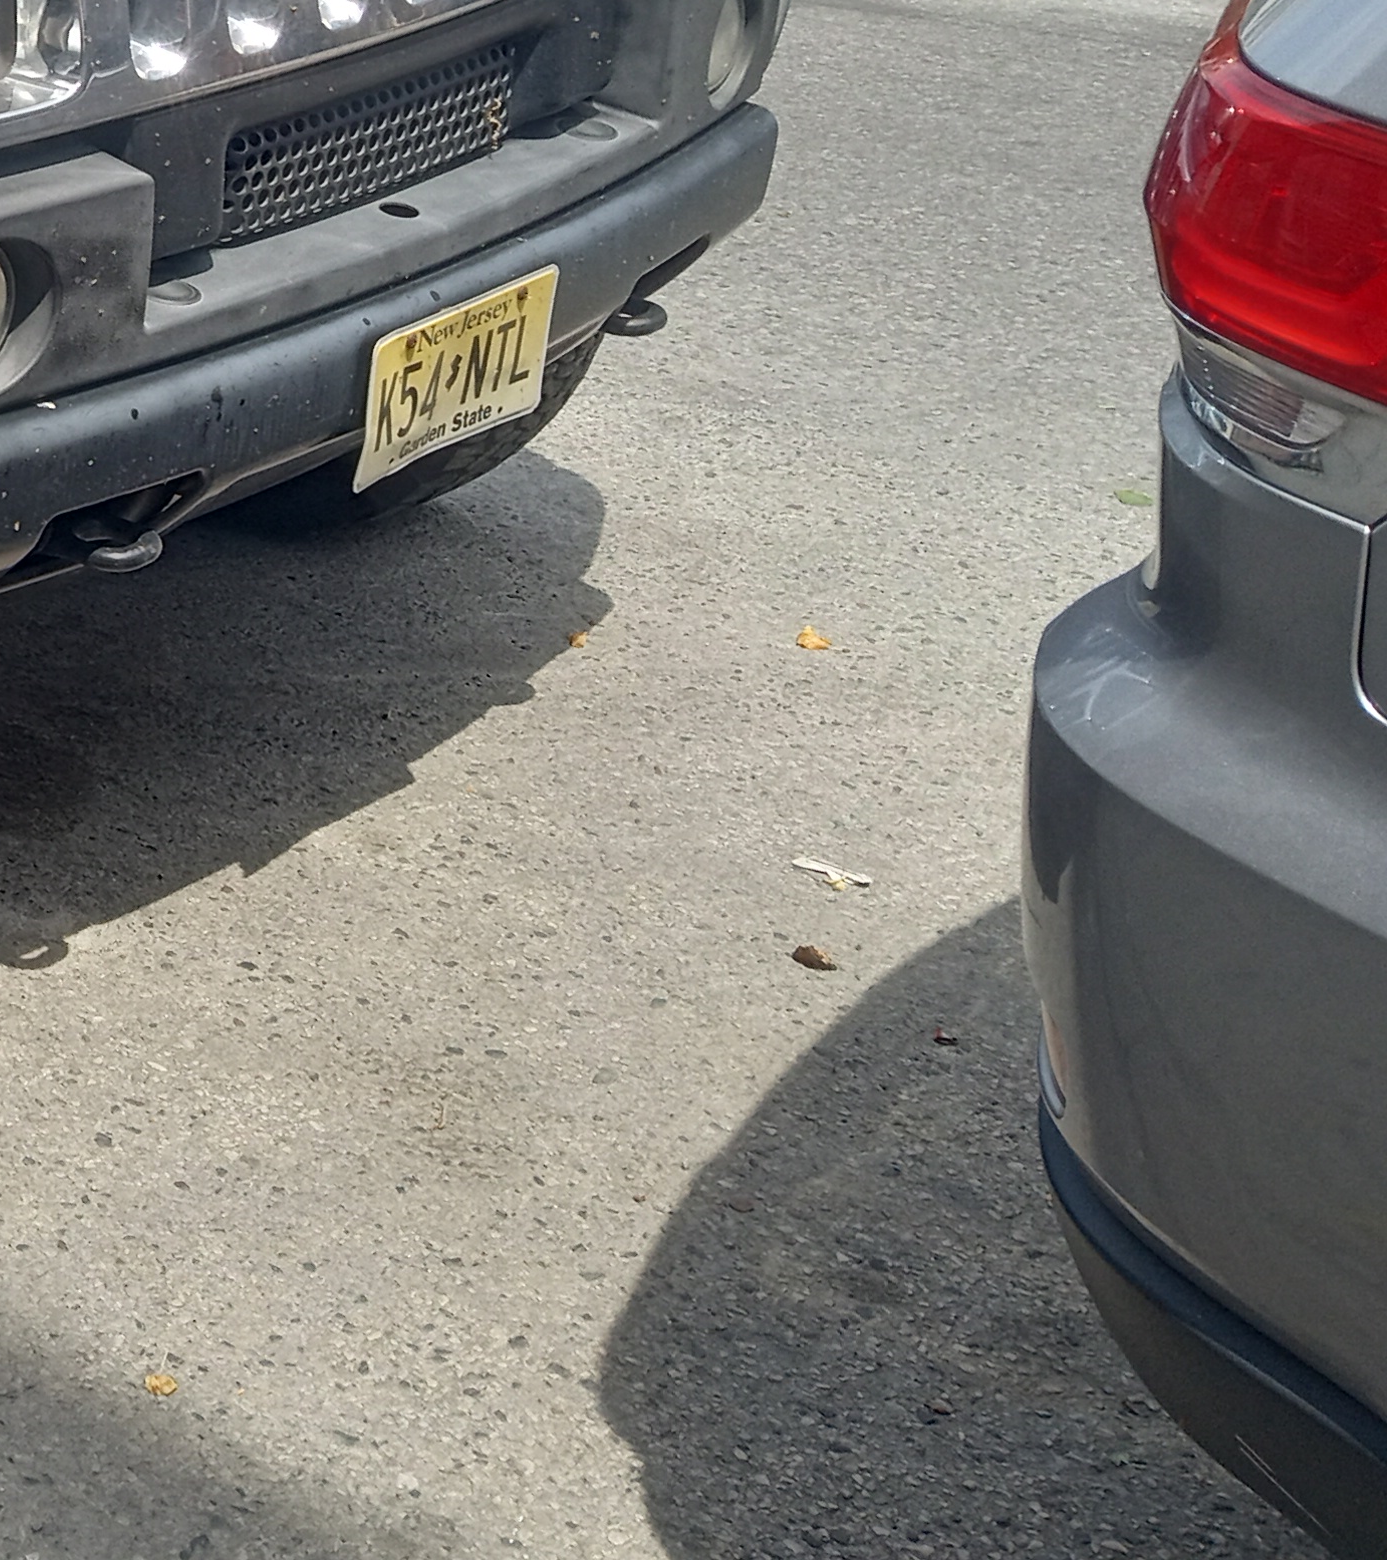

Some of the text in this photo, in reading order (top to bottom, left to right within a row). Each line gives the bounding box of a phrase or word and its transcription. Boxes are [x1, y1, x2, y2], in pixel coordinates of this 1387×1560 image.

[416, 299, 513, 354] New Jersey
[398, 403, 493, 460] Garden State
